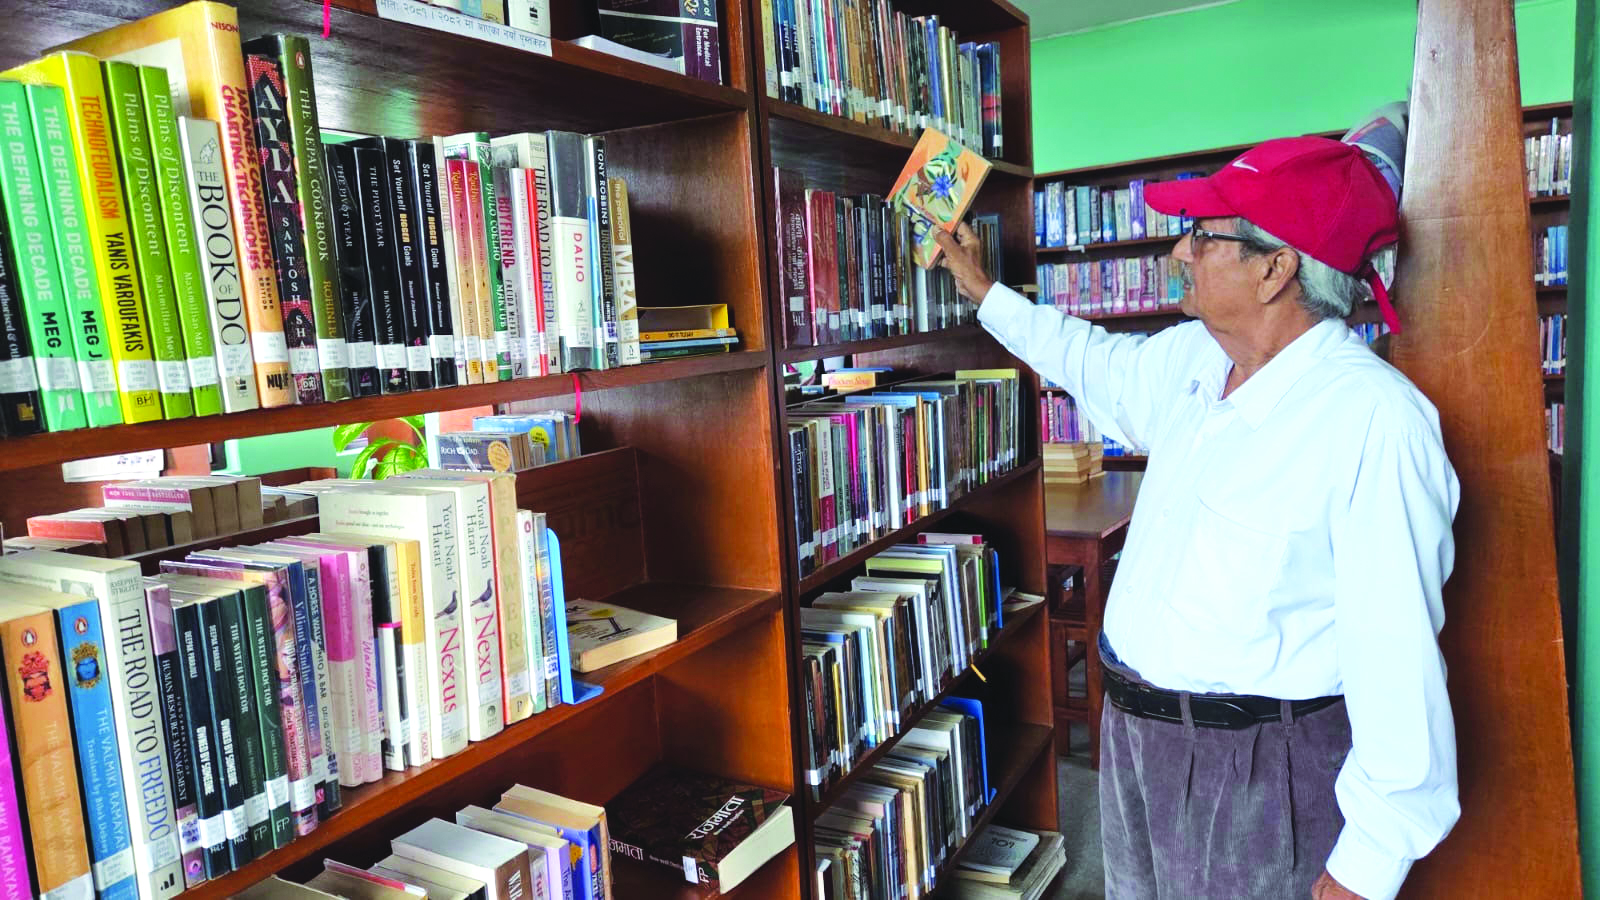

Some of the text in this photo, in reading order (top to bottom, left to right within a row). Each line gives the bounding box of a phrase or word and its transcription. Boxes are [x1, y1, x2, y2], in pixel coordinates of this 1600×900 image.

[80, 96, 121, 219] TECHNOFEUDALISM
[123, 92, 160, 256] Plains of Discontent
[154, 95, 190, 255] Plains of Discontent
[222, 85, 261, 271] CHARTING TECHNIQUES
[392, 159, 401, 174] Set
[422, 163, 431, 177] Set
[597, 148, 607, 178] TONY
[395, 176, 408, 211] Yourself
[425, 180, 436, 214] Yourself
[534, 165, 546, 199] THE
[600, 180, 608, 225] ROBBINS
[0, 102, 62, 348] THE DEFINING DECADE MEG
[43, 105, 100, 346] THE DEFINING DECADE MEG
[250, 168, 273, 270] CANDLESTICK
[299, 88, 336, 323] THE NEPAL COOKBOOK ROHINI
[336, 165, 353, 247] THE PIVOT YEAR
[369, 166, 385, 247] THE PIVOT YEAR
[537, 198, 550, 241] ROAD
[615, 203, 625, 242] personal
[105, 232, 130, 270] YANIS
[198, 171, 237, 294] THE BOOK OF
[498, 196, 516, 268] BOYFRIEND
[403, 245, 413, 267] Goals
[430, 247, 439, 269] Goals
[485, 182, 506, 328] PAULO COELHO MAKTUB
[540, 246, 552, 267] TO
[573, 232, 585, 282] DALIO
[505, 279, 514, 307] FREIDA
[615, 245, 636, 317] MBA
[114, 274, 144, 352] VAROUFAKIS
[352, 291, 363, 328] BRIANNA
[383, 290, 393, 326] BRIANNA
[441, 447, 456, 455] RICH
[432, 524, 443, 568] Harari
[442, 504, 457, 581] Yuval Noah
[466, 515, 479, 556] Harari
[476, 496, 492, 569] Yuval Noah
[308, 577, 316, 585] A
[309, 586, 320, 616] HORSE
[118, 609, 145, 656] THE
[295, 600, 306, 641] Valiant
[230, 622, 249, 713] THE WITCH DOCTOR
[255, 616, 273, 706] THE WITCH DOCTOR
[361, 640, 377, 694] Warmth
[439, 626, 460, 713] Nexus
[125, 655, 154, 719] ROAD
[320, 682, 328, 699] BAR
[96, 709, 110, 734] THE
[134, 722, 158, 753] TO
[162, 659, 187, 801] HUMAN RESOURCE MANAGEMENT
[196, 726, 209, 753] OWNED
[220, 718, 233, 745] OWNED
[101, 735, 117, 789] VALMIKI
[199, 751, 210, 763] BY
[223, 743, 234, 755] BY
[276, 817, 290, 833] FP
[698, 867, 711, 884] FP
